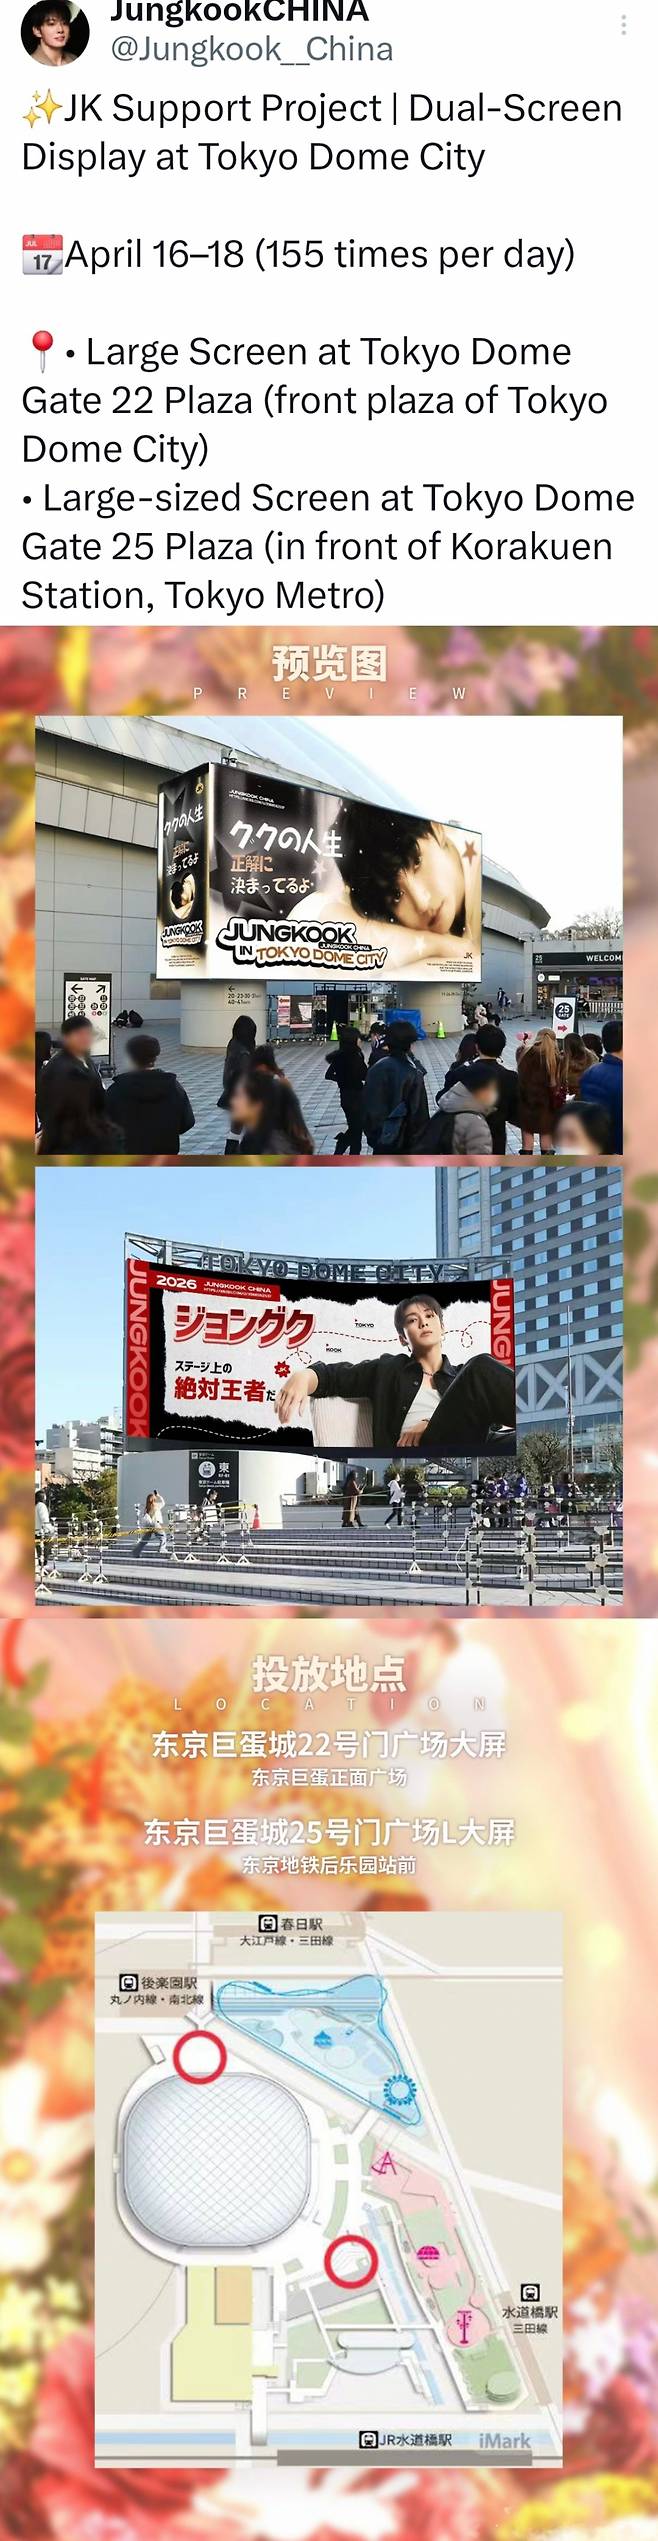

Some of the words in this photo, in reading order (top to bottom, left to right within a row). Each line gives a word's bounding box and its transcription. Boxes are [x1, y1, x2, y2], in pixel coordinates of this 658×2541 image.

[230, 854, 274, 873] 正解に
[163, 923, 203, 937] JUNGKOOK
[223, 923, 354, 943] JUNGKOOK
[239, 946, 253, 955] IN
[257, 946, 310, 960] TOKYO
[313, 950, 354, 964] DOME
[356, 952, 385, 965] CITY
[559, 1005, 570, 1013] 25
[298, 1262, 366, 1282] DOME
[156, 1275, 197, 1290] 2026
[204, 1281, 246, 1291] JUNGKOOK
[248, 1286, 272, 1294] CHINA
[174, 1304, 315, 1350] ジョングク
[493, 1280, 512, 1366] JUNG
[175, 1360, 232, 1374] ステージ上の
